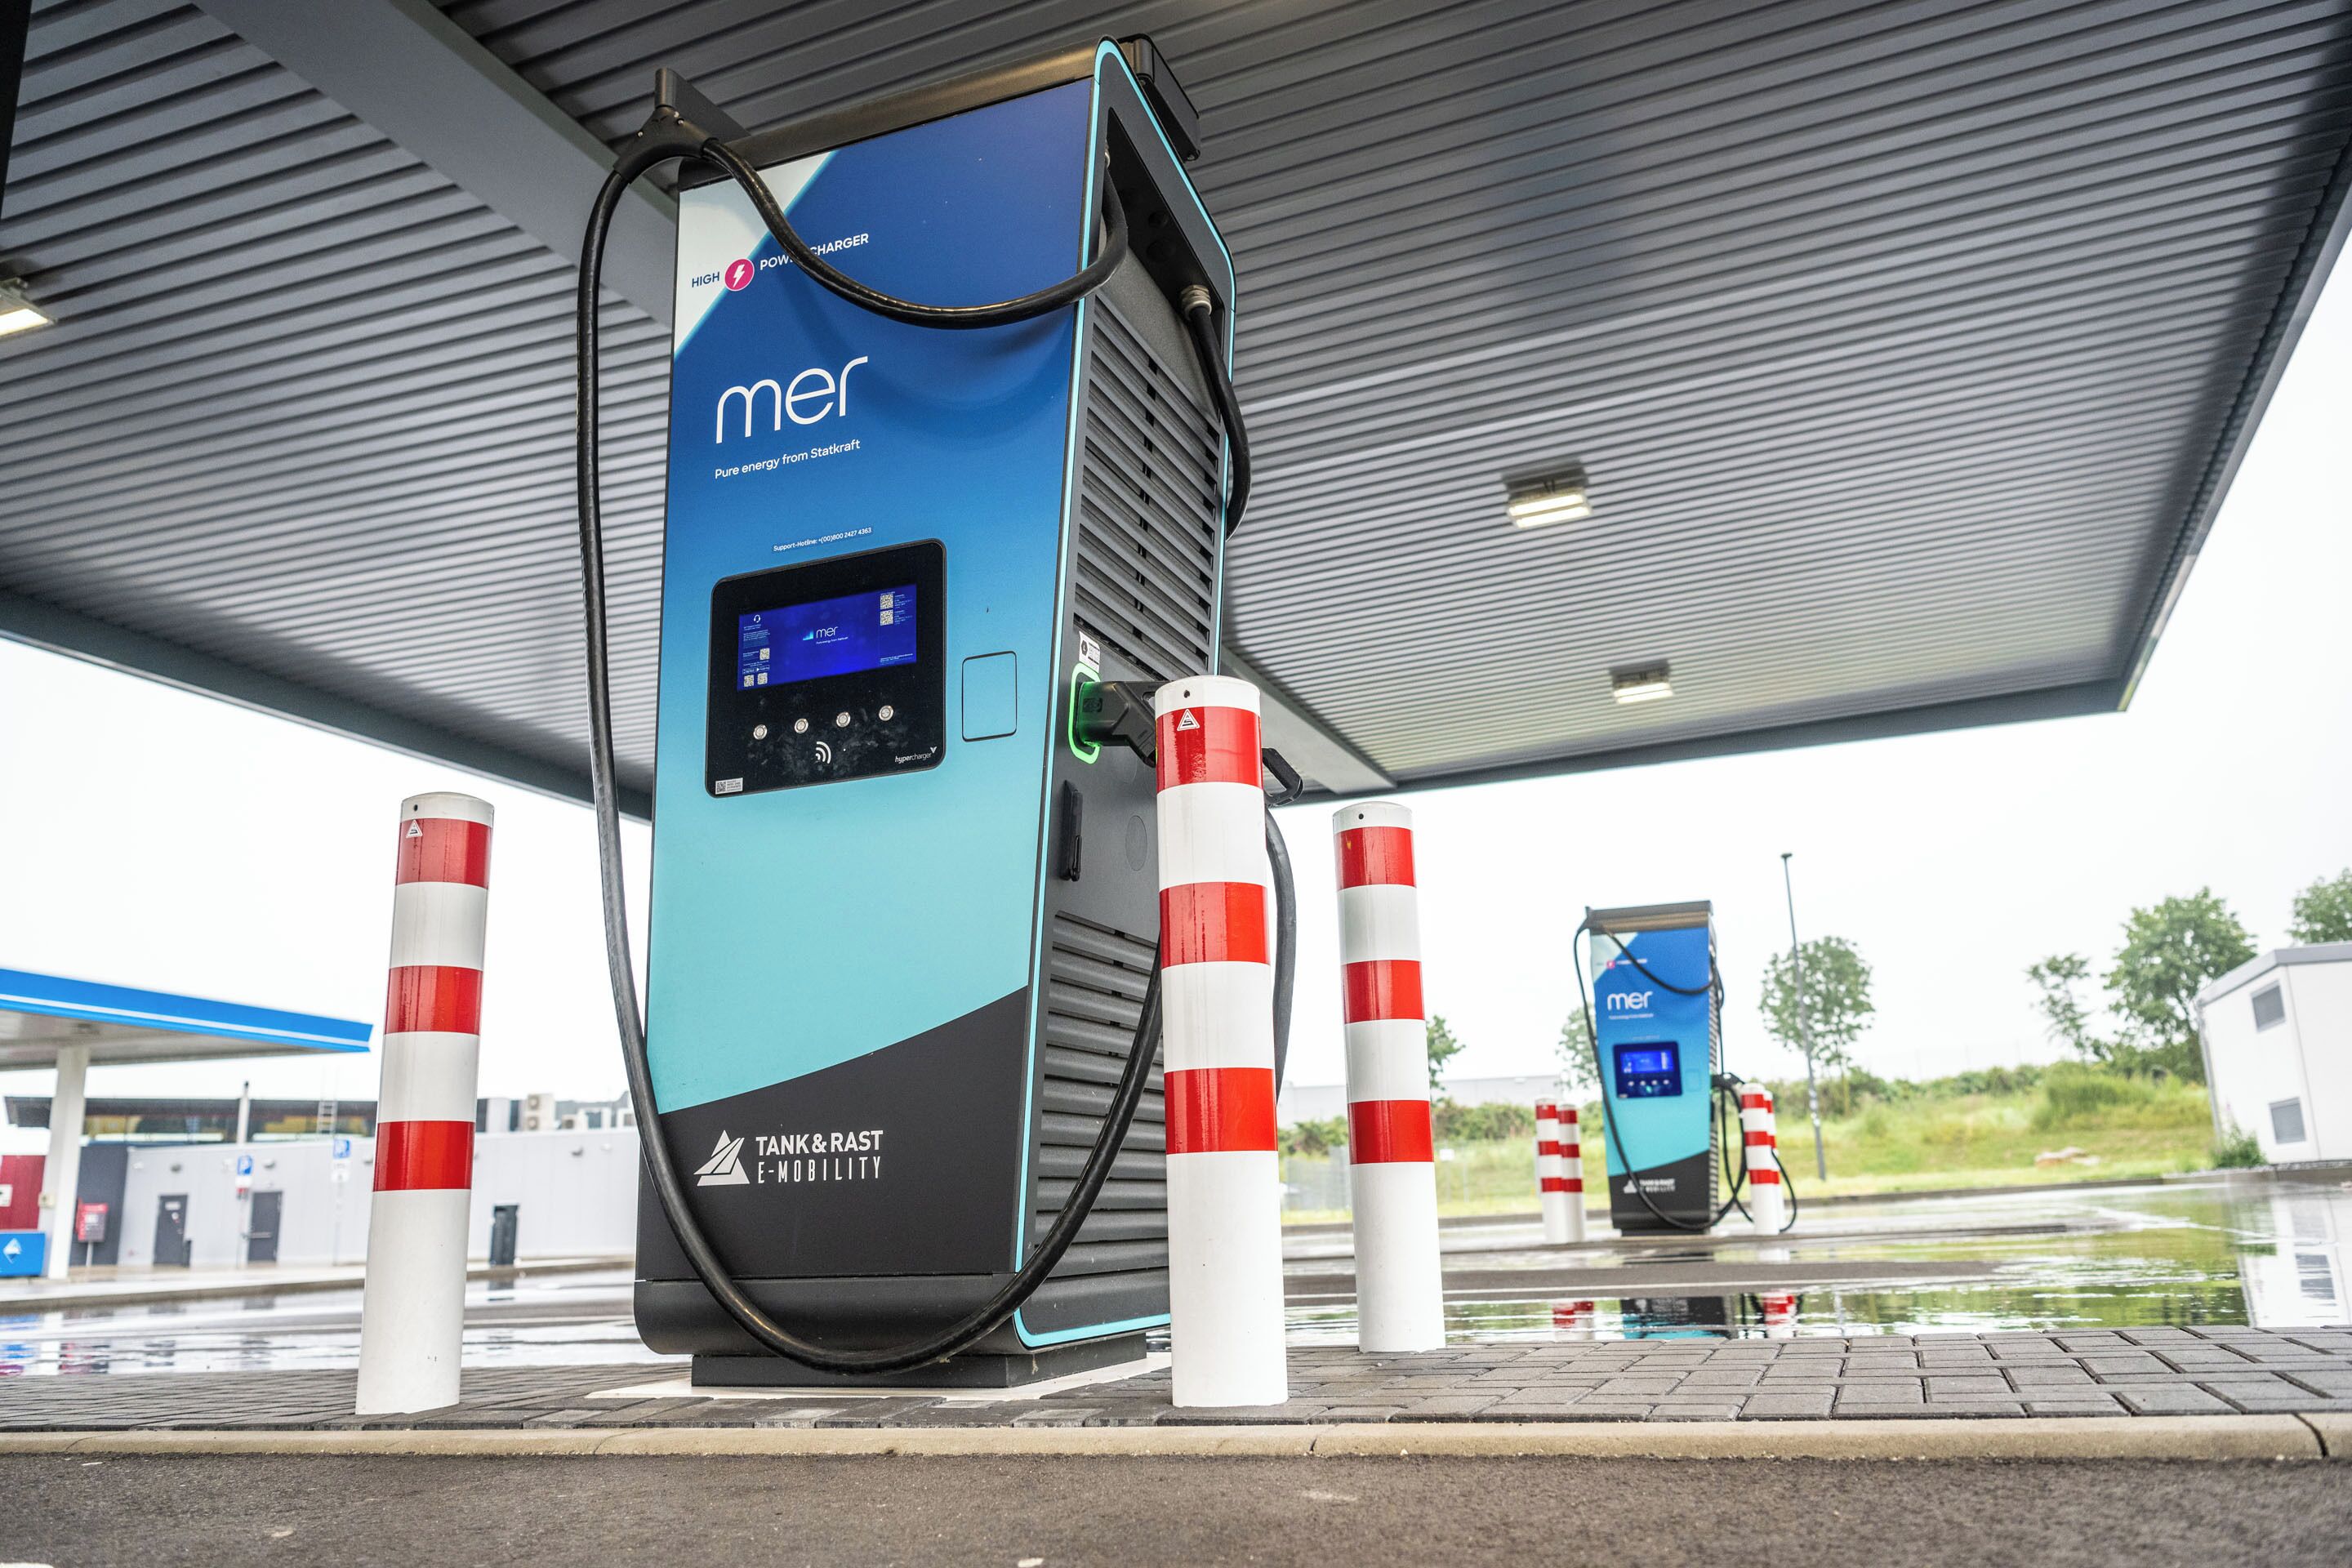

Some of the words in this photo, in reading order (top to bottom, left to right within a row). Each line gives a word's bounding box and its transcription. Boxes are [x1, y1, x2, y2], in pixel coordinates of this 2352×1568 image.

[692, 271, 719, 287] HIGH
[760, 254, 793, 270] POW
[715, 356, 868, 444] mer
[715, 466, 739, 479] Pure
[742, 457, 780, 474] energy
[782, 452, 808, 465] from
[810, 439, 861, 459] Statkraft
[844, 530, 858, 538] 2427
[816, 626, 839, 638] mer
[894, 753, 932, 764] hypercharger
[1607, 991, 1654, 1011] mer
[758, 1156, 881, 1183] E-MOBILITY
